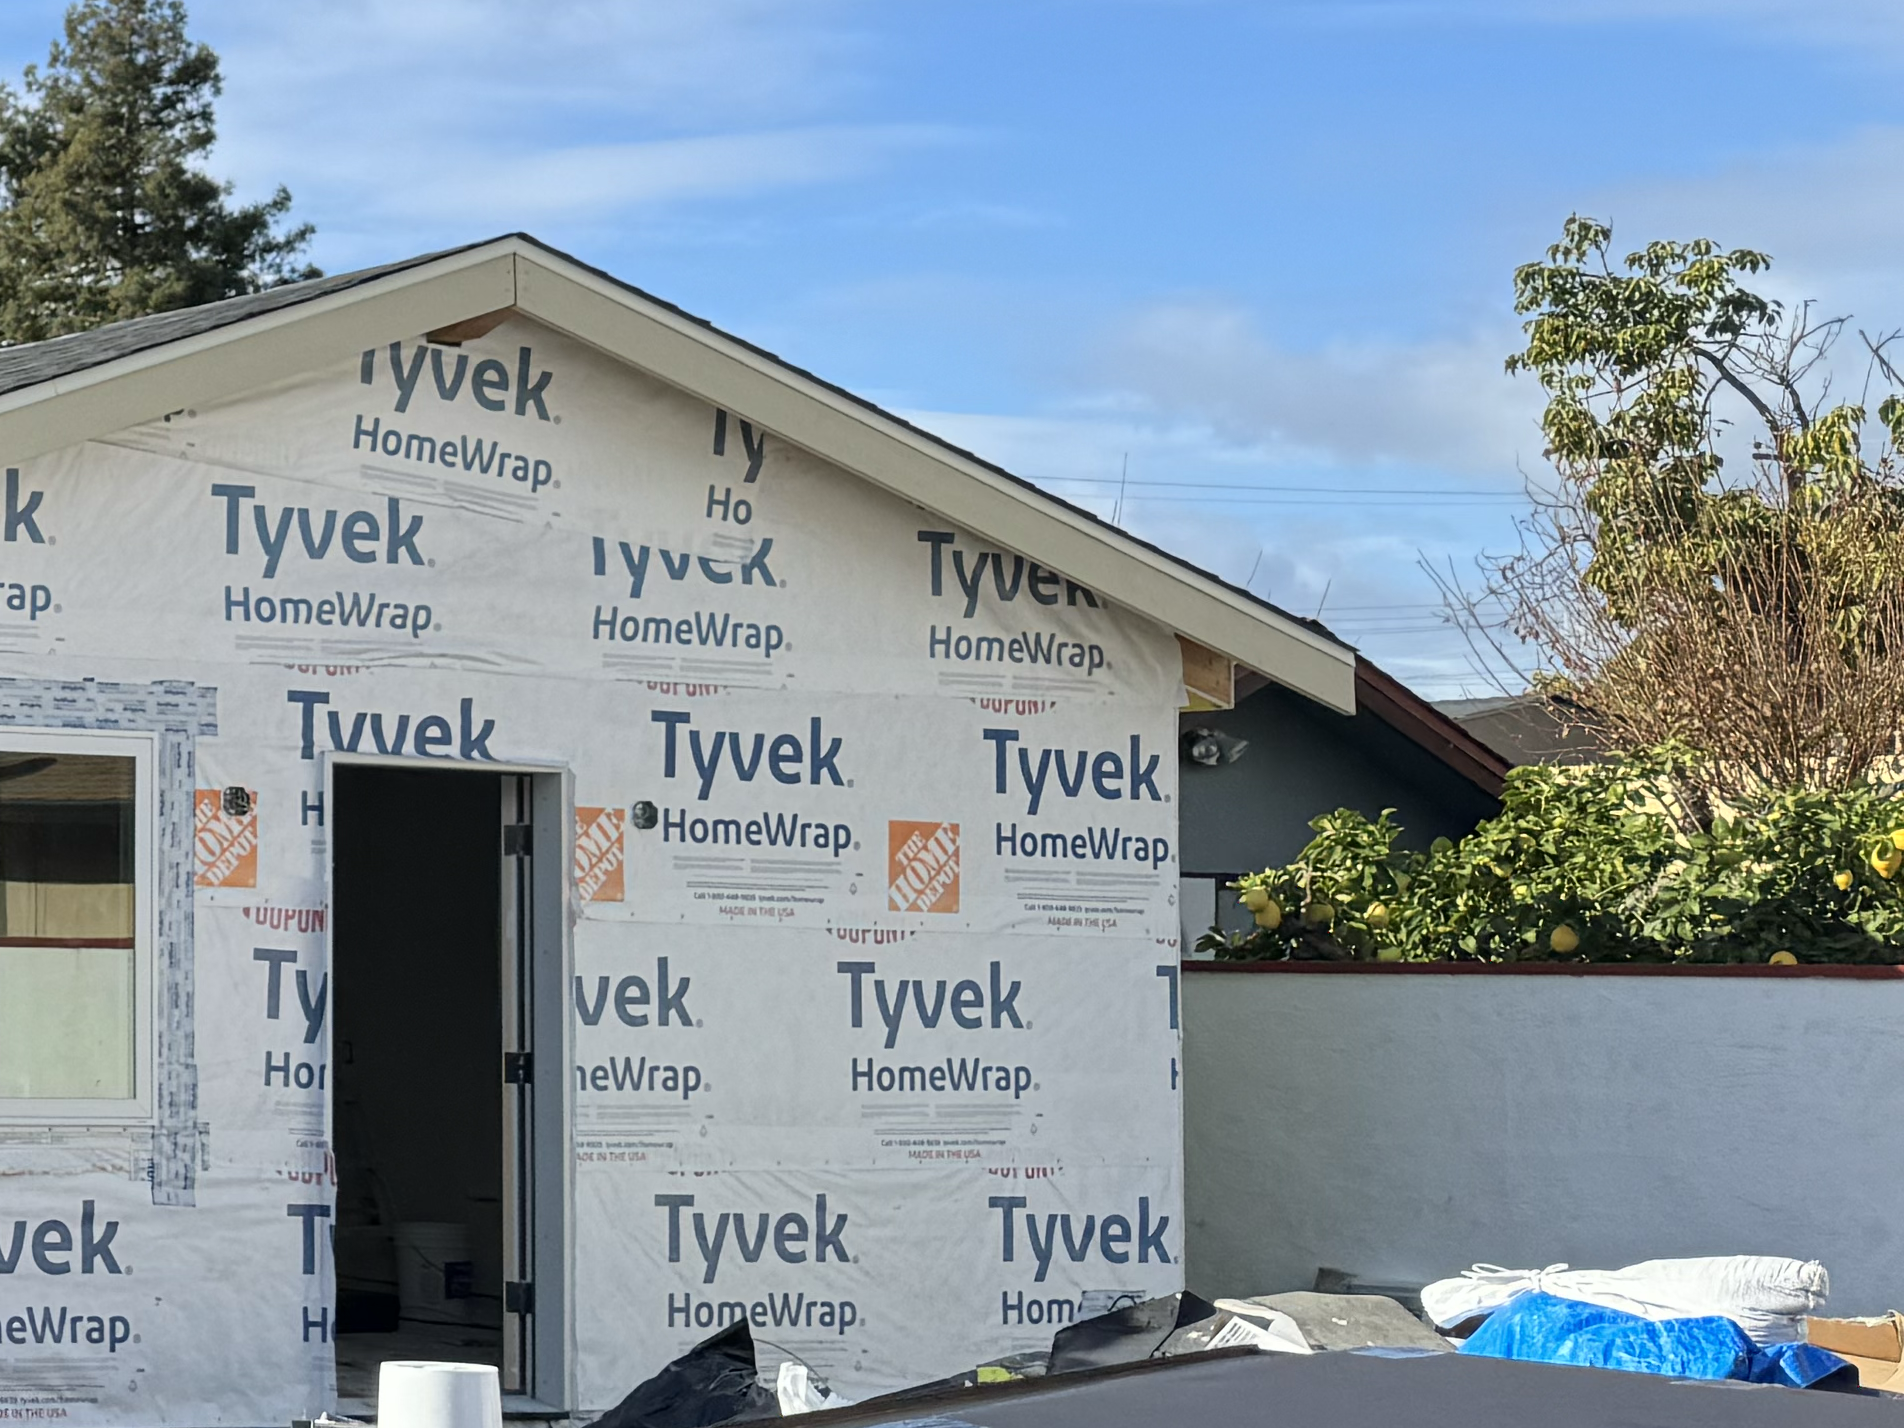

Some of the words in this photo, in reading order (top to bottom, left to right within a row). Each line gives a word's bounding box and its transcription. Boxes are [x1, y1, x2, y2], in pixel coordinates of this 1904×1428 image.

[353, 413, 553, 493] HomeWrap
[211, 483, 425, 579] Tyvek
[224, 585, 432, 638] HomeWrap
[592, 605, 784, 659] HomeWrap
[929, 624, 1105, 677] HomeWrap
[650, 709, 845, 801] Tyvek
[982, 727, 1163, 816] Tyvek
[663, 808, 852, 856] HomeWrap
[895, 830, 926, 866] THE
[995, 822, 1170, 871] HomeWrap
[889, 821, 960, 912] HOME
[916, 856, 960, 912] DEPOT
[836, 960, 1025, 1050] Tyvek
[851, 1057, 1032, 1100] HomeWrap
[654, 1193, 851, 1285] Tyvek
[988, 1195, 1172, 1283] Tyvek
[667, 1292, 857, 1336] HomeWrap
[1001, 1290, 1082, 1325] Hom
[25, 1408, 44, 1421] THE
[47, 1408, 68, 1419] USA
